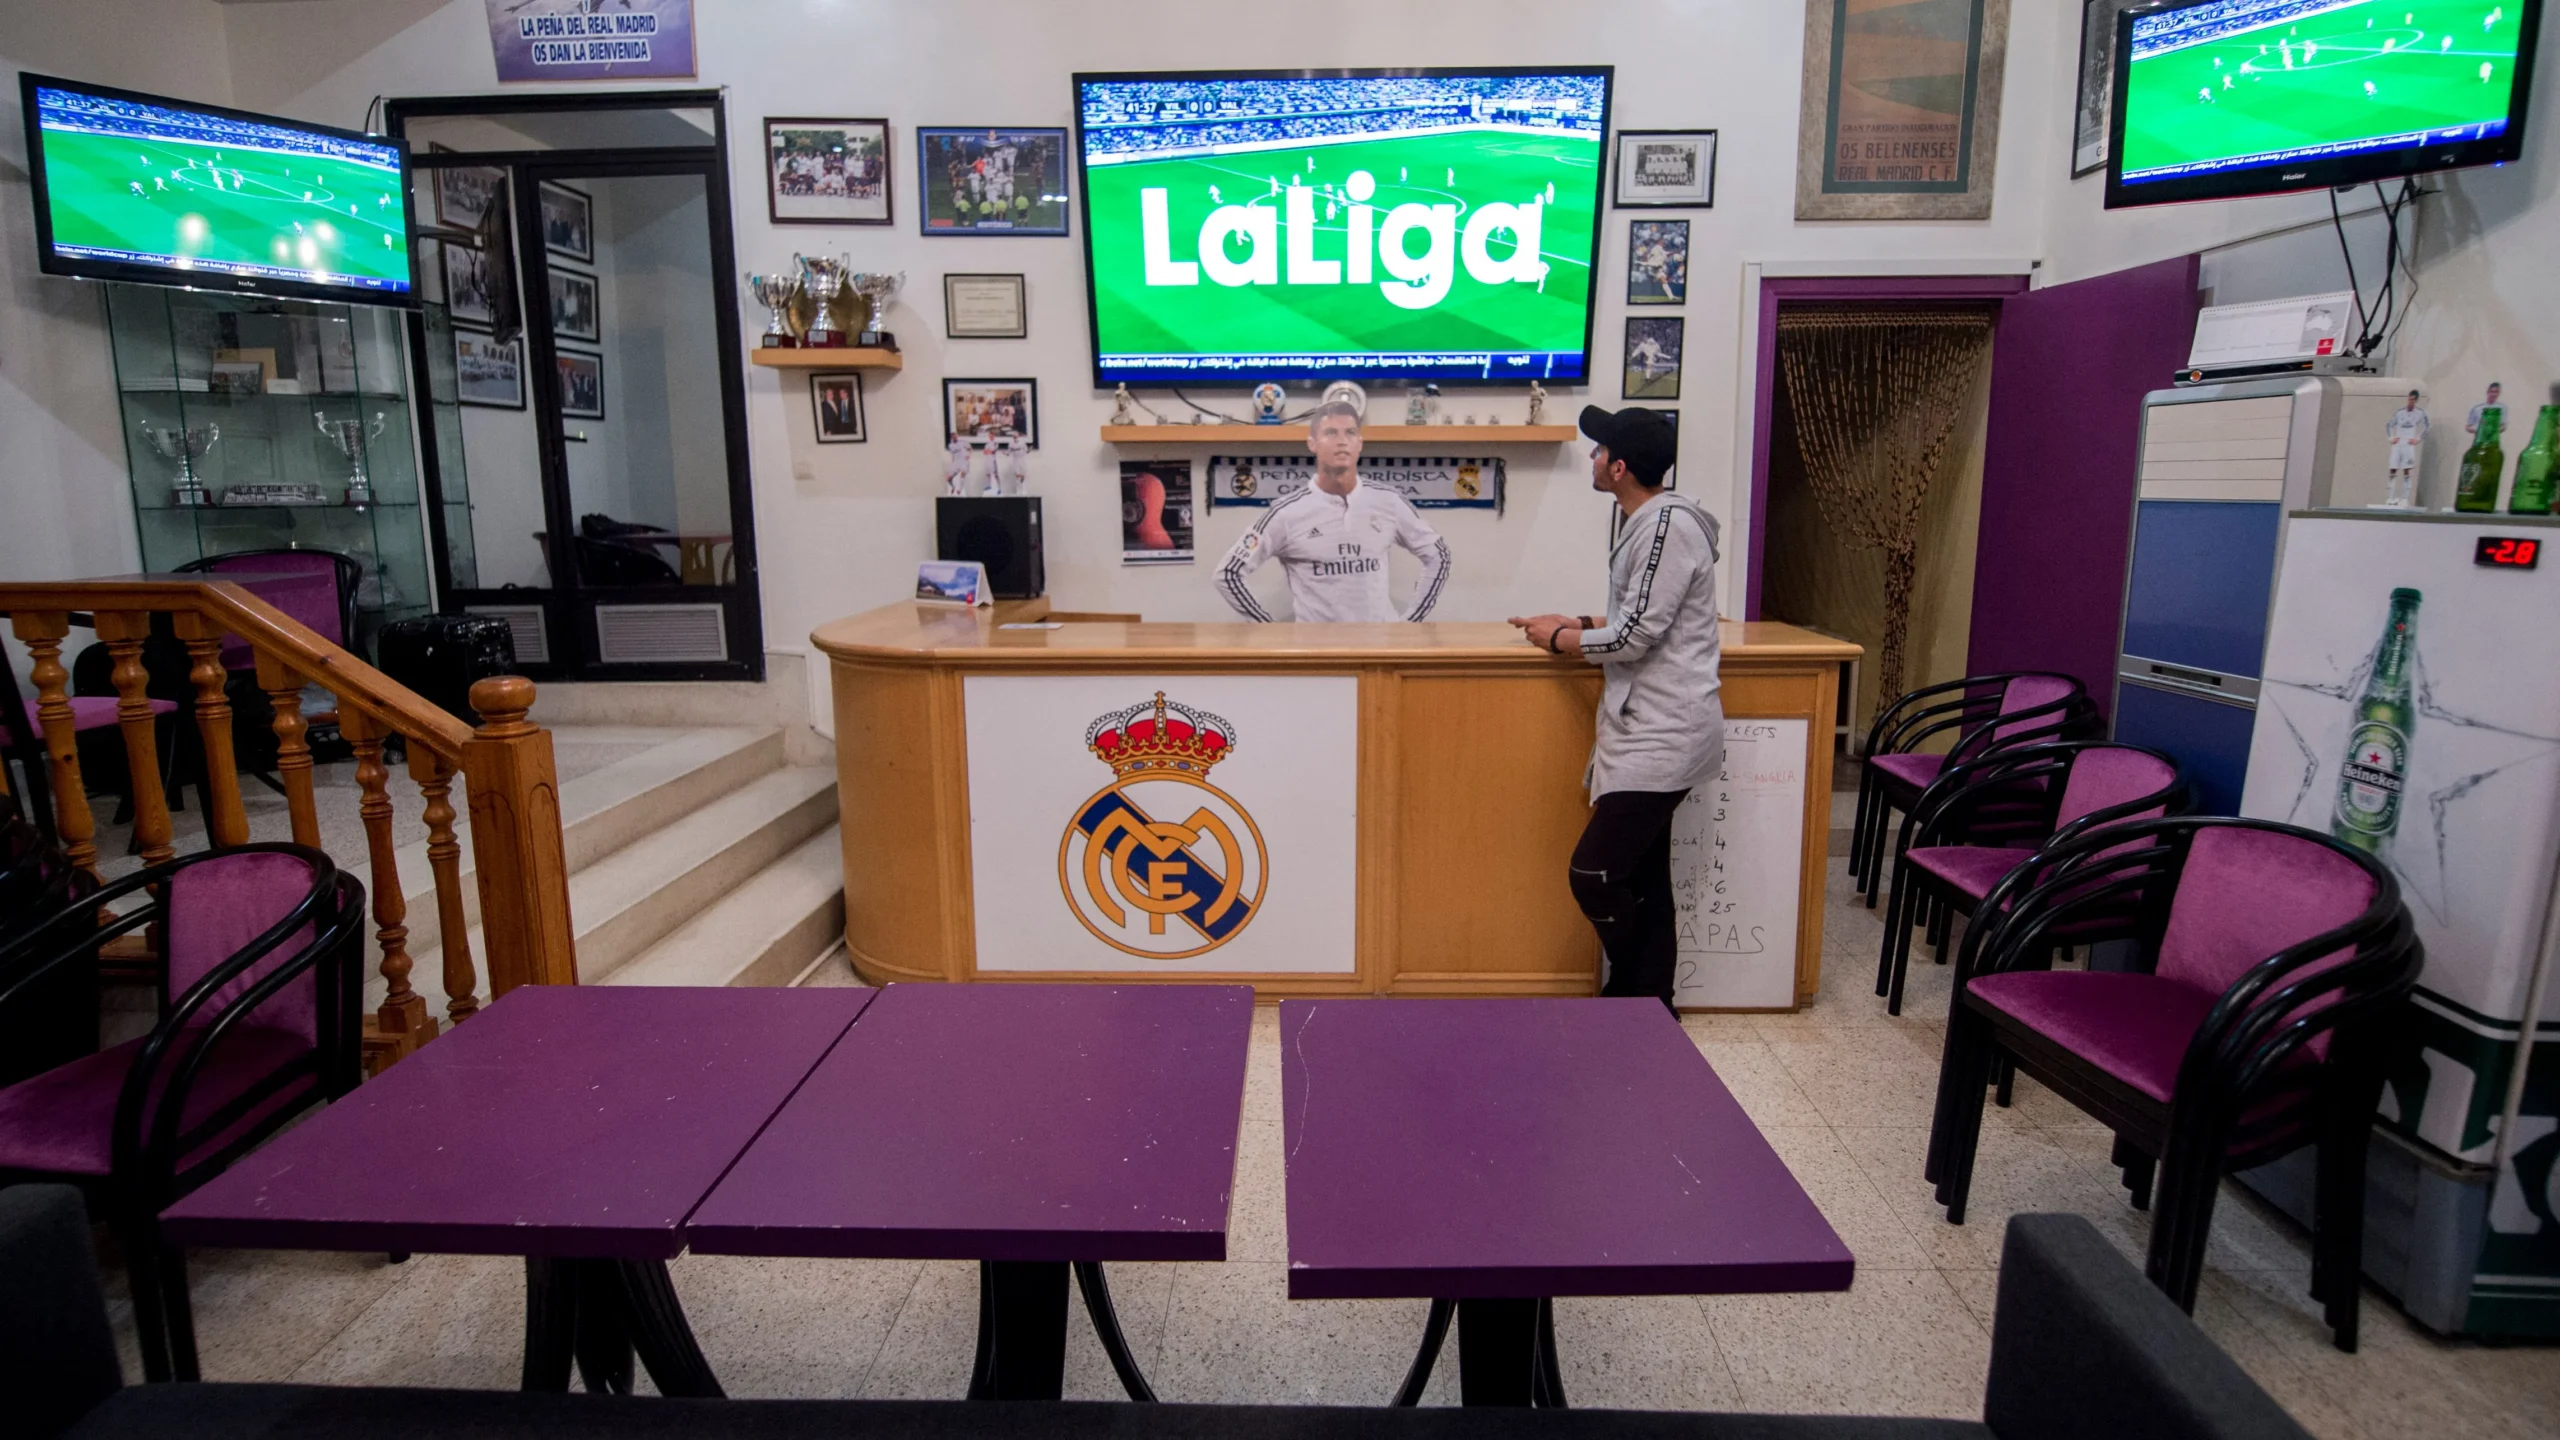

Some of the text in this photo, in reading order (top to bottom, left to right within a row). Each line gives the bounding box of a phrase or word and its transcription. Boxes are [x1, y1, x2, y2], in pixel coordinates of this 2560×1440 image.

[521, 13, 656, 36] LA PEÑA DEL REAL MADRID
[534, 41, 648, 62] OS DAN LA BIENVENIDA
[1126, 101, 1157, 114] 41:37
[1841, 142, 1956, 159] OS BELENENSES
[1839, 166, 1867, 181] REAL
[1876, 166, 1923, 181] MADRID
[2282, 173, 2307, 182] Haier
[1141, 170, 1542, 309] LaLiga
[1260, 468, 1310, 480] PEÑA
[1338, 543, 1360, 556] Fly
[1312, 556, 1380, 576] Emirate
[1720, 771, 1729, 781] 2
[2343, 763, 2402, 791] Heineken
[1720, 793, 1730, 802] 2
[1713, 808, 1726, 821] 3
[1671, 835, 1726, 851] OCA 4
[1714, 859, 1724, 873] 4
[1714, 880, 1727, 894] 6
[1709, 901, 1737, 914] 25
[1676, 921, 1766, 952] APAS
[1678, 960, 1704, 989] 2
